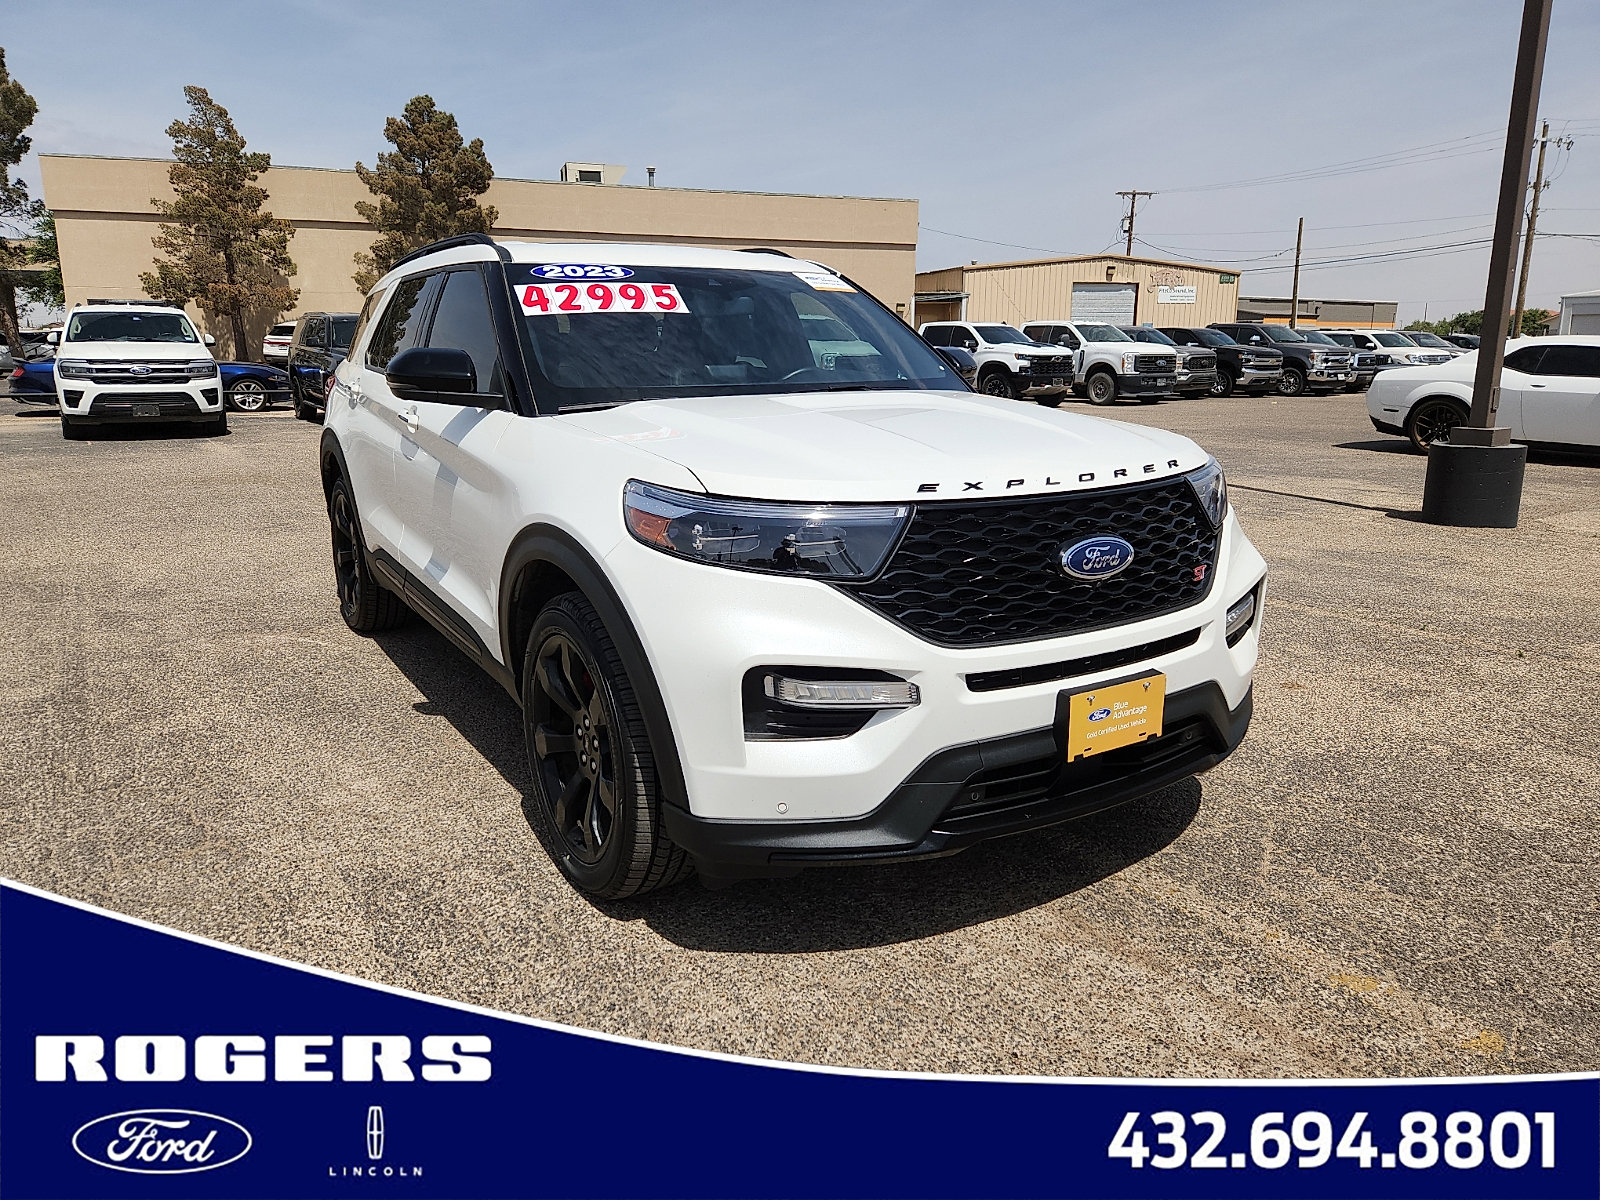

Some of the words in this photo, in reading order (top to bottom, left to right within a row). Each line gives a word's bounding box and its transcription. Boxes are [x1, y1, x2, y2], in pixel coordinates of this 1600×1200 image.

[543, 265, 625, 278] 2023
[522, 284, 678, 312] 42995
[916, 458, 1180, 493] EXPLORER
[1082, 545, 1121, 570] Ford
[1192, 564, 1206, 581] ST
[1113, 701, 1128, 710] Blue
[1113, 705, 1147, 720] Advantage
[1087, 731, 1097, 739] Gold
[1098, 726, 1118, 736] Certified
[1118, 722, 1129, 731] Used
[1130, 718, 1146, 727] Vehicle
